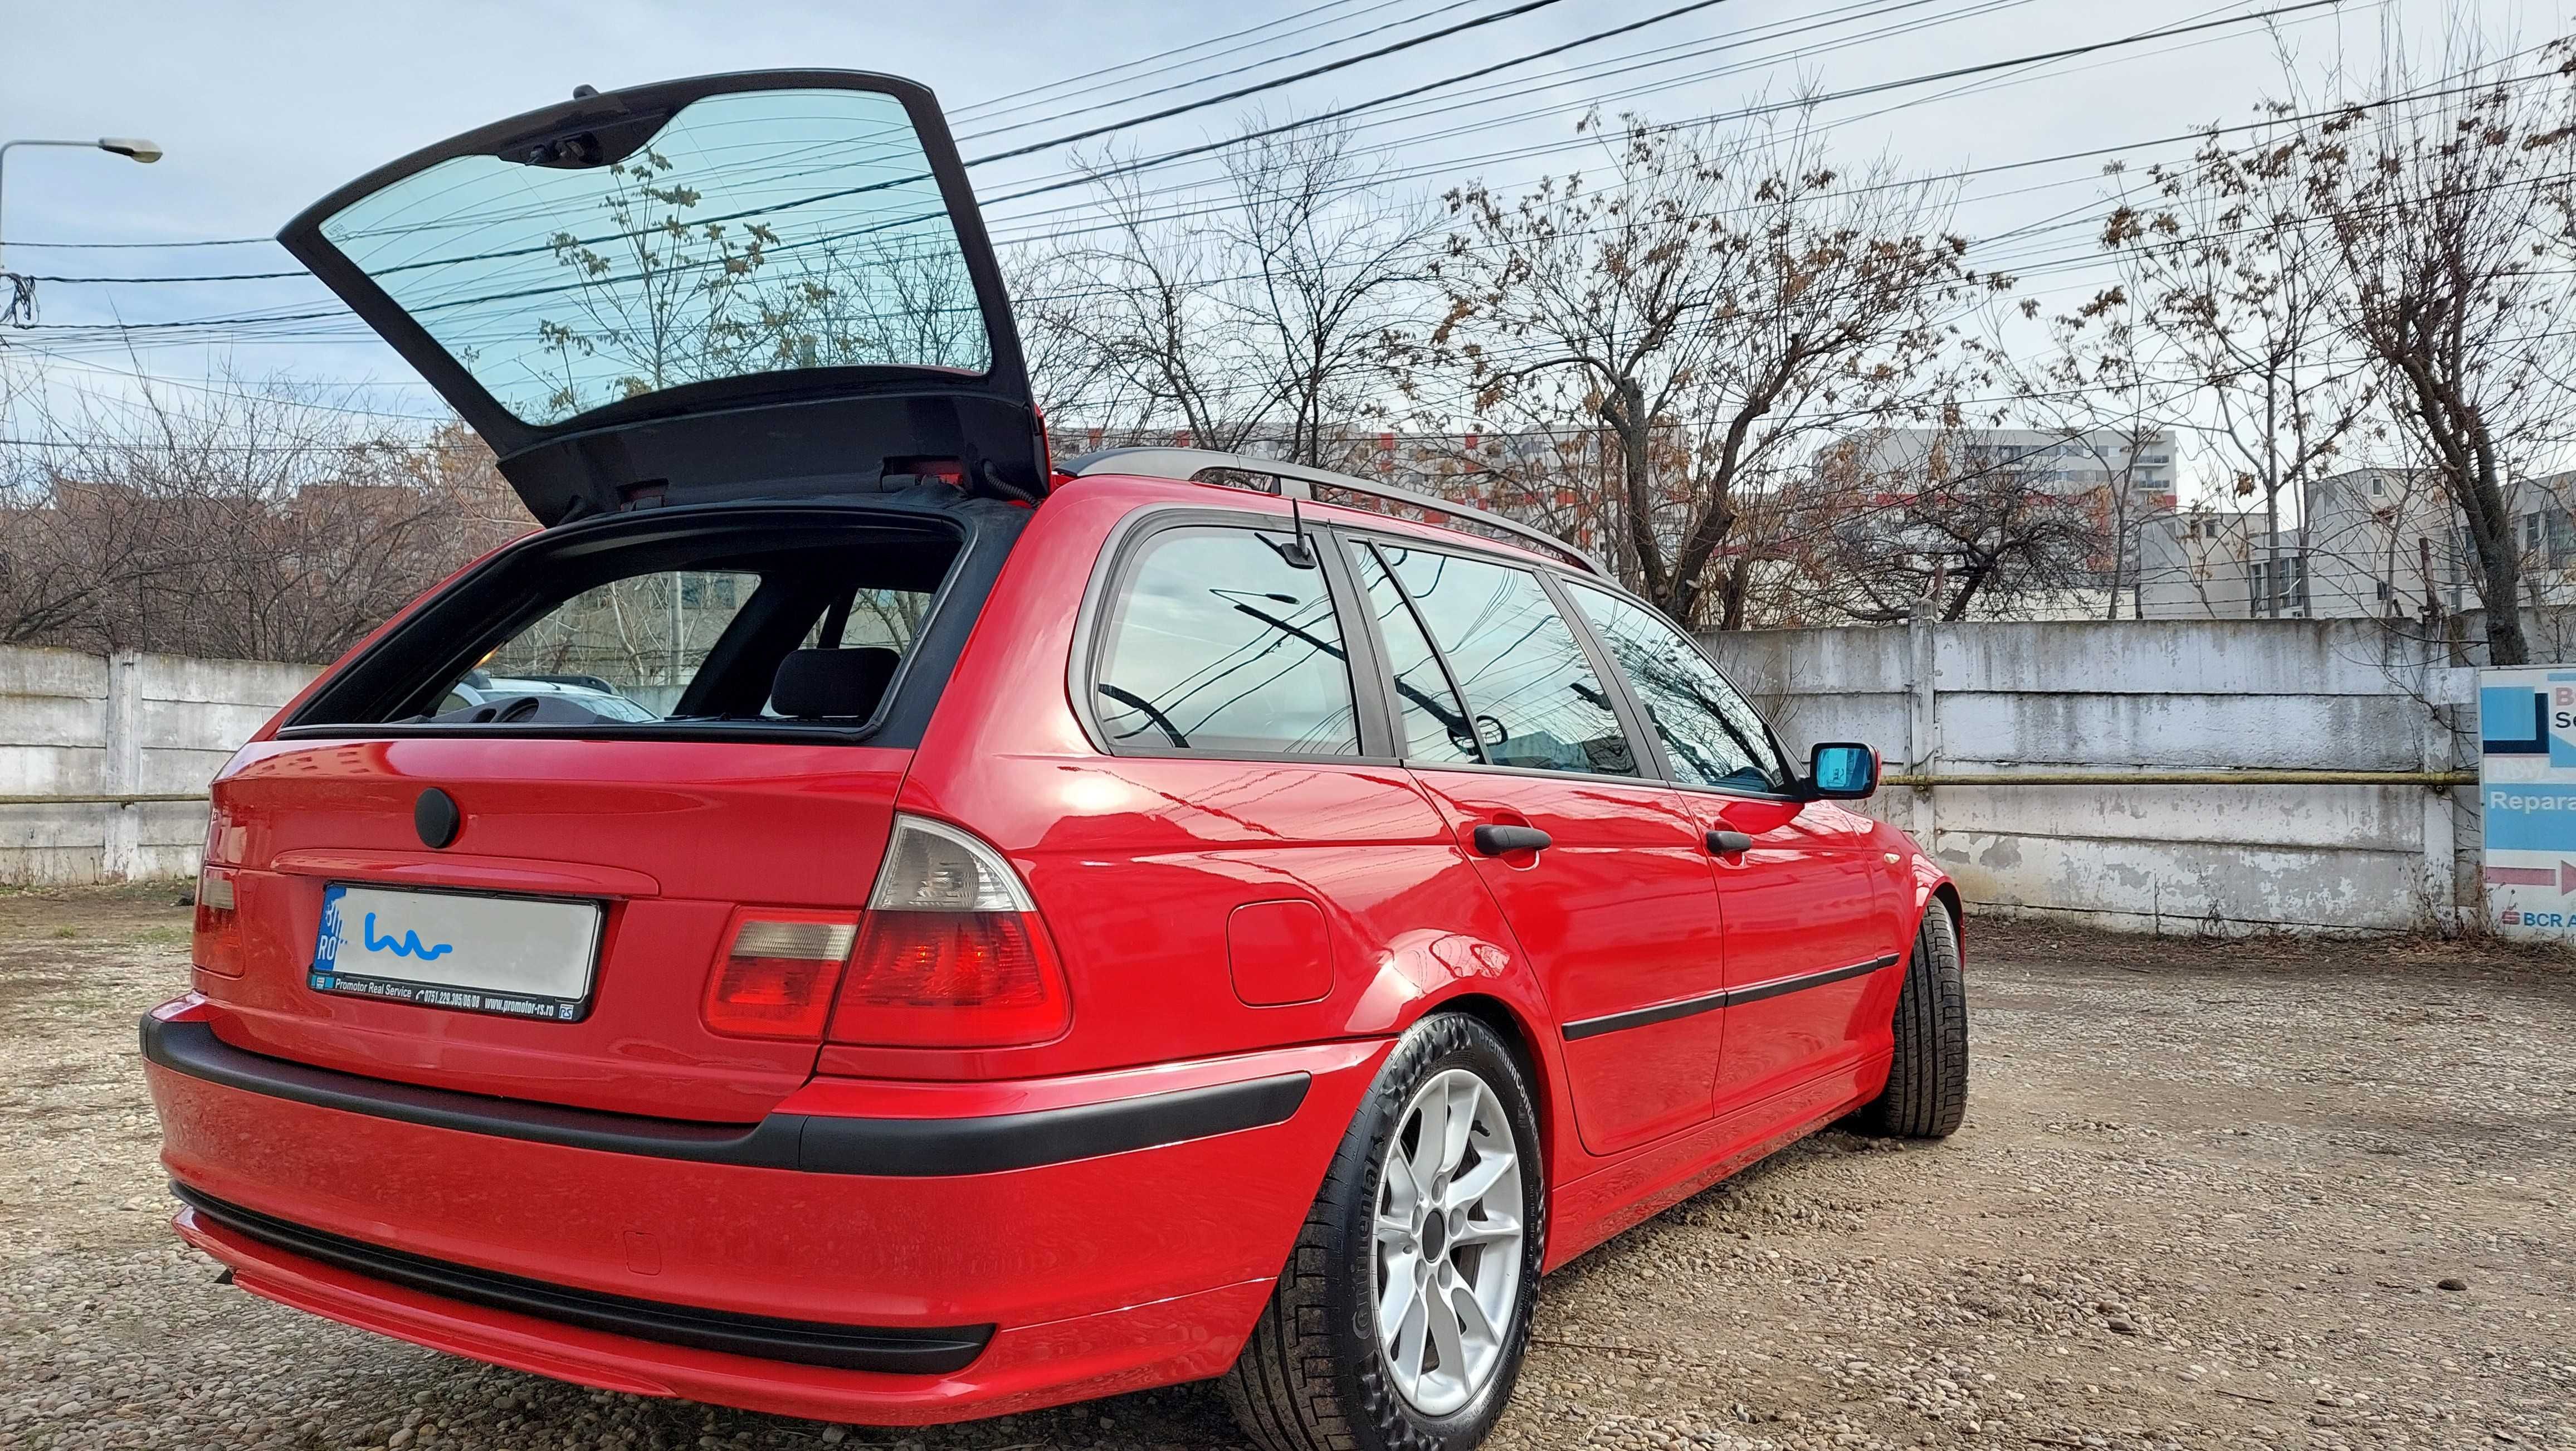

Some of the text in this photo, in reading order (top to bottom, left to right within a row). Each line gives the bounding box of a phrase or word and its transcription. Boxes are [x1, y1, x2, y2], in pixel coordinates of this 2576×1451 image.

[2556, 687, 2576, 706] B
[2555, 712, 2576, 729] S
[2524, 912, 2563, 927] BCR
[317, 934, 336, 960] RO
[335, 978, 367, 992] Promotor
[368, 982, 385, 995] Real
[385, 983, 412, 998] Service
[424, 990, 480, 1008] 0751.229.305/06/08
[485, 997, 554, 1016] www.promotor-rs.ro
[559, 1007, 573, 1018] RS
[1352, 1153, 1380, 1339] Continental
